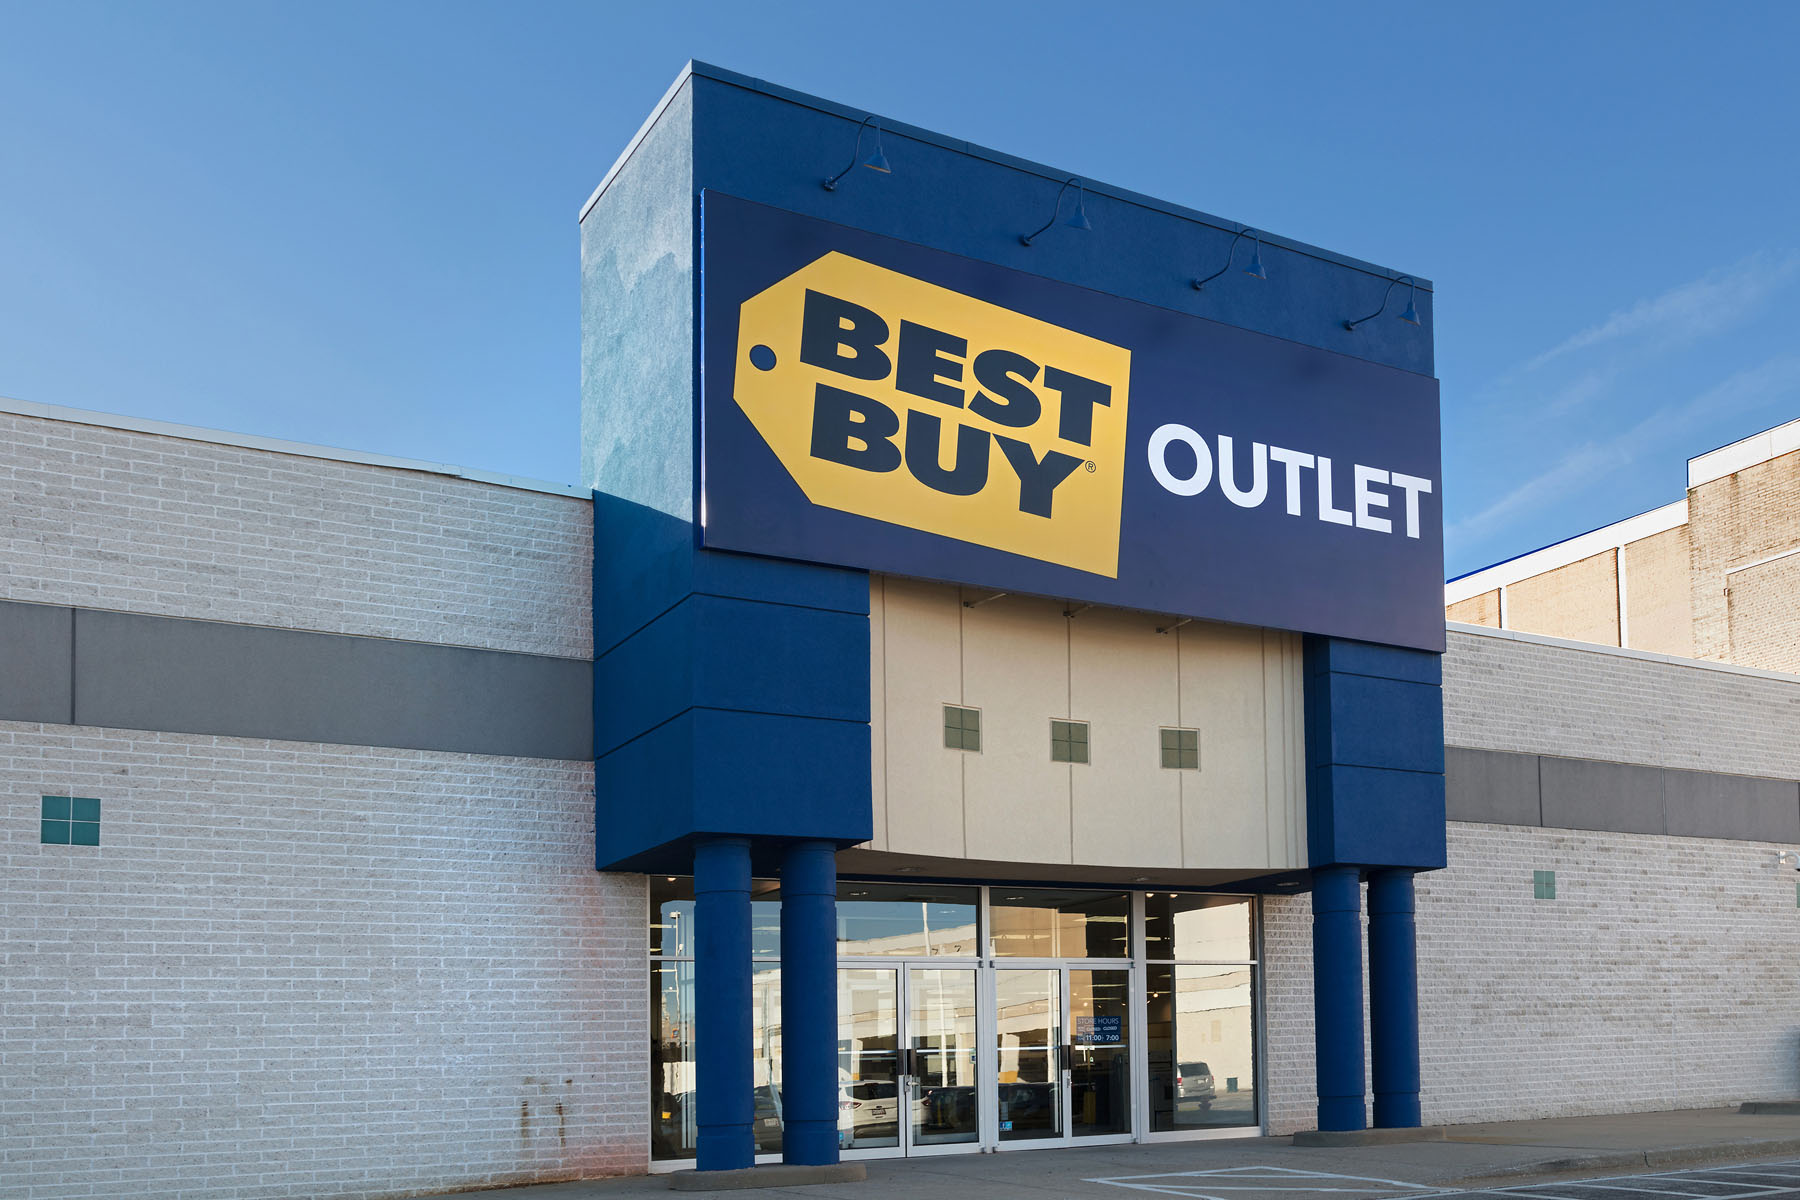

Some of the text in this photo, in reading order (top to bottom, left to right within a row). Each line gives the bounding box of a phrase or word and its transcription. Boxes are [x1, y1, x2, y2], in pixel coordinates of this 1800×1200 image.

[799, 287, 1112, 448] BEST
[810, 382, 1086, 519] BUY
[1147, 423, 1432, 540] OUTLET
[1077, 1017, 1119, 1025] STORE HOURS
